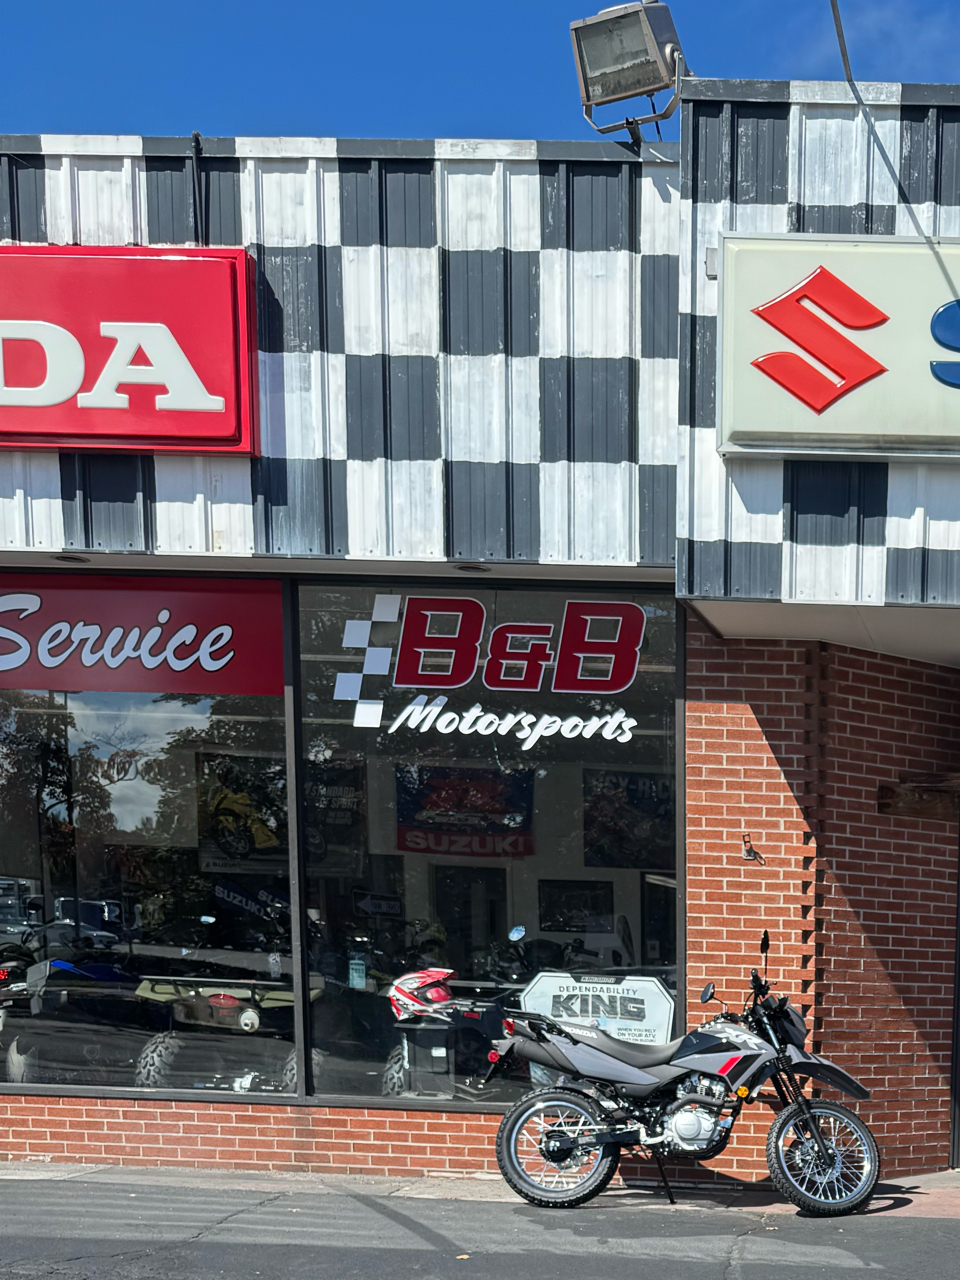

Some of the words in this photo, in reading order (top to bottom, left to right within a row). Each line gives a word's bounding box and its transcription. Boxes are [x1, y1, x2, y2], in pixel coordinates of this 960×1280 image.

[0, 592, 235, 672] Service
[391, 594, 647, 695] B&B
[388, 694, 639, 751] Motorsports
[330, 797, 359, 810] SPORT
[405, 831, 524, 854] SUZUKI
[214, 885, 266, 918] SUZUKI
[558, 985, 639, 996] DEPENDABILITY
[551, 994, 647, 1022] KING
[561, 1025, 598, 1039] HONDA
